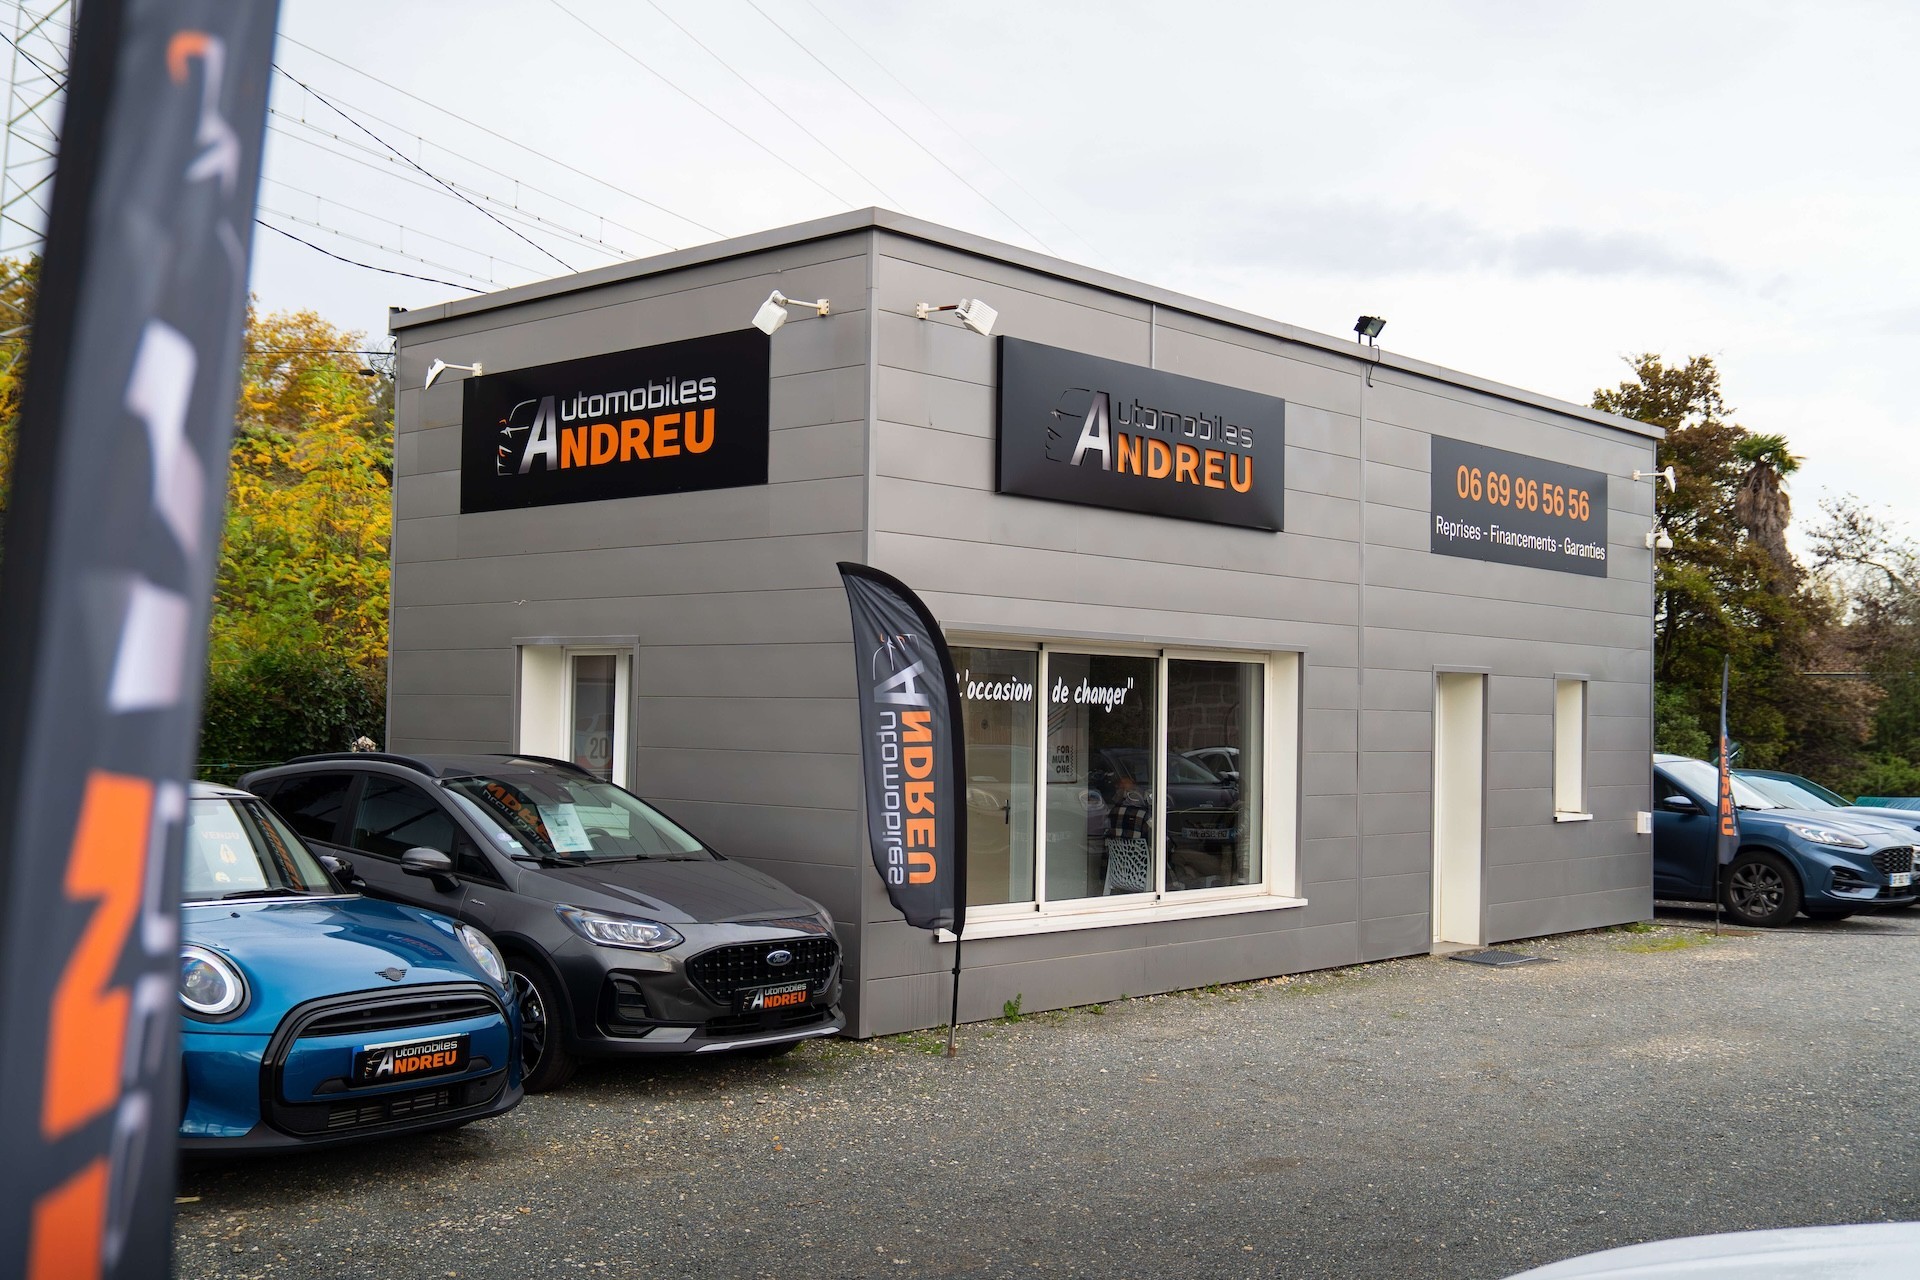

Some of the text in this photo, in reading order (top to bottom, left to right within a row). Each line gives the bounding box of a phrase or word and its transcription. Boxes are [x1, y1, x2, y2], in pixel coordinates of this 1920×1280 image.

[1457, 464, 1590, 522] 06 69 96 56 56
[1436, 515, 1481, 541] Reprises
[1490, 524, 1557, 553] Financements
[1564, 537, 1606, 561] Garanties
[1052, 676, 1069, 703] de
[1074, 677, 1134, 713] changer"
[590, 737, 608, 759] 20
[1056, 766, 1070, 775] ONE
